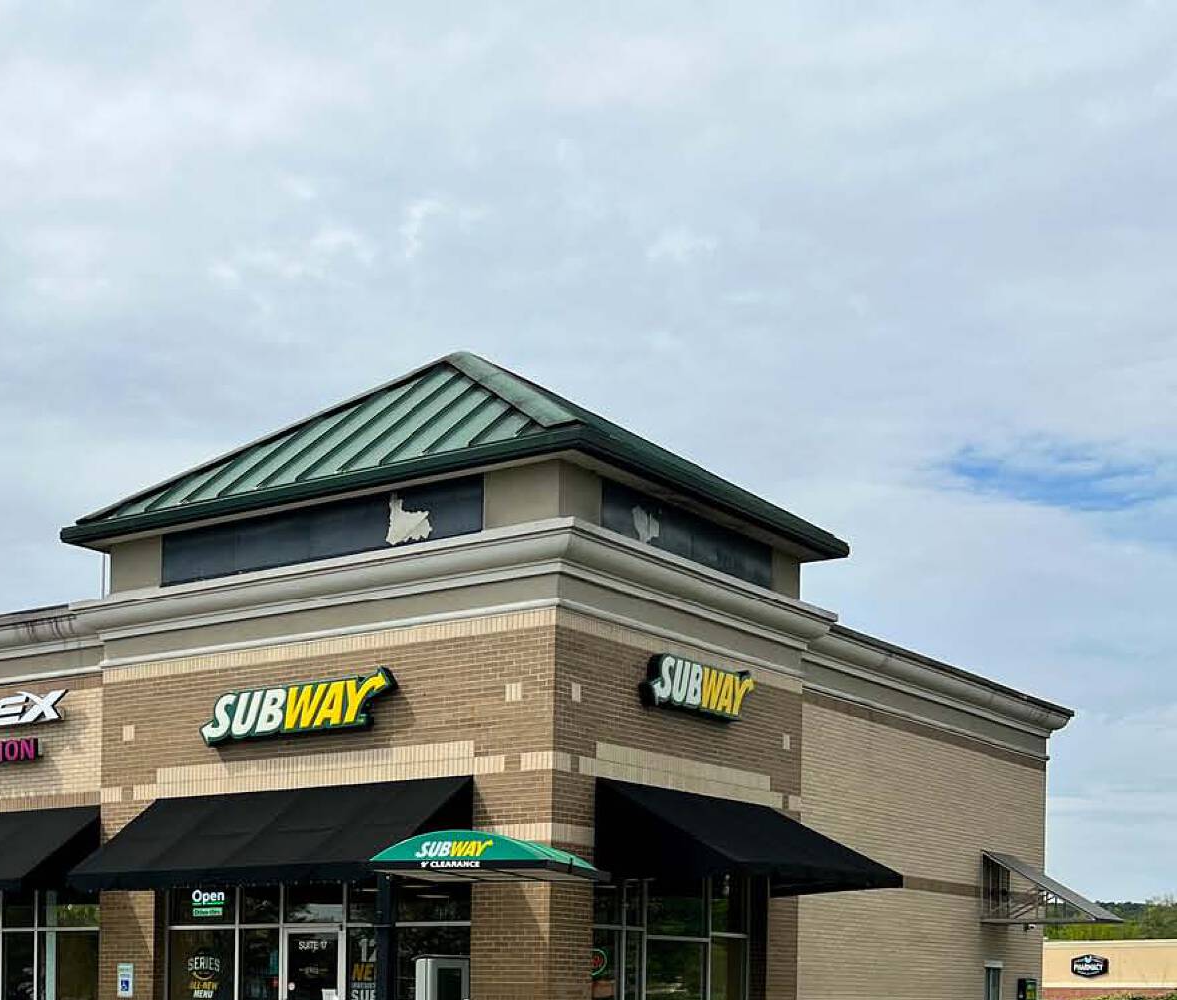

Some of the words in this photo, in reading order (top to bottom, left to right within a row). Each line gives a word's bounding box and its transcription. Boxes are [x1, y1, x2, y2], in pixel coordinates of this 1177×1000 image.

[651, 656, 755, 717] SUBWAY
[201, 673, 387, 741] SUBWAY
[416, 839, 493, 858] SUBWAY
[430, 860, 481, 868] CLEARANCE
[191, 889, 225, 906] Open
[187, 956, 221, 972] SERIES
[193, 990, 214, 999] MENU
